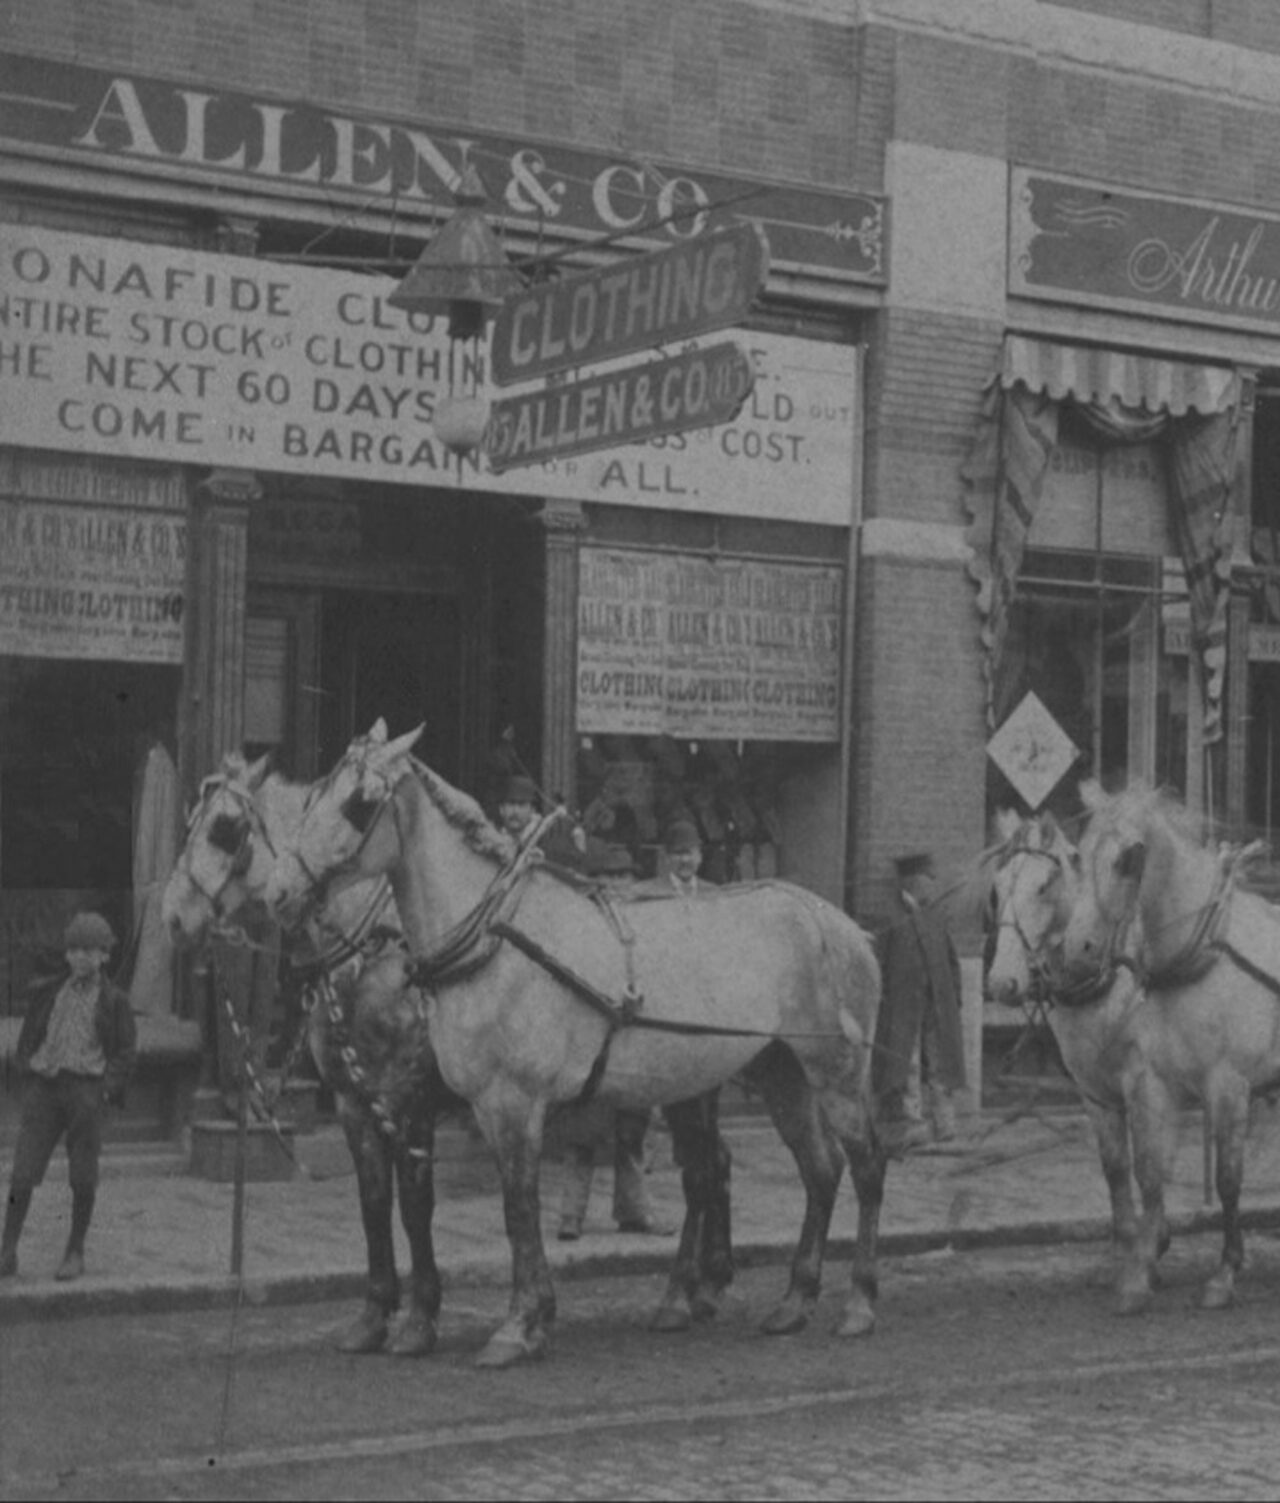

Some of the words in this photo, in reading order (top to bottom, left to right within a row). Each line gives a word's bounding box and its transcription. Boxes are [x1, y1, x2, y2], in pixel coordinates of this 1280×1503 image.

[72, 78, 482, 200] ALLEN
[505, 150, 566, 217] &
[592, 165, 709, 240] CO
[86, 352, 216, 400] NEXT
[237, 371, 291, 404] 60
[313, 379, 436, 424] DAYS
[130, 313, 266, 361] STOCK
[305, 335, 486, 388] CLOTHIN
[58, 399, 204, 445] COME
[228, 424, 255, 444] IN
[283, 422, 491, 474] BARGAIN
[600, 460, 699, 494] ALL.
[510, 379, 629, 457] ALLEN
[630, 374, 654, 428] &
[720, 428, 812, 466] COST.
